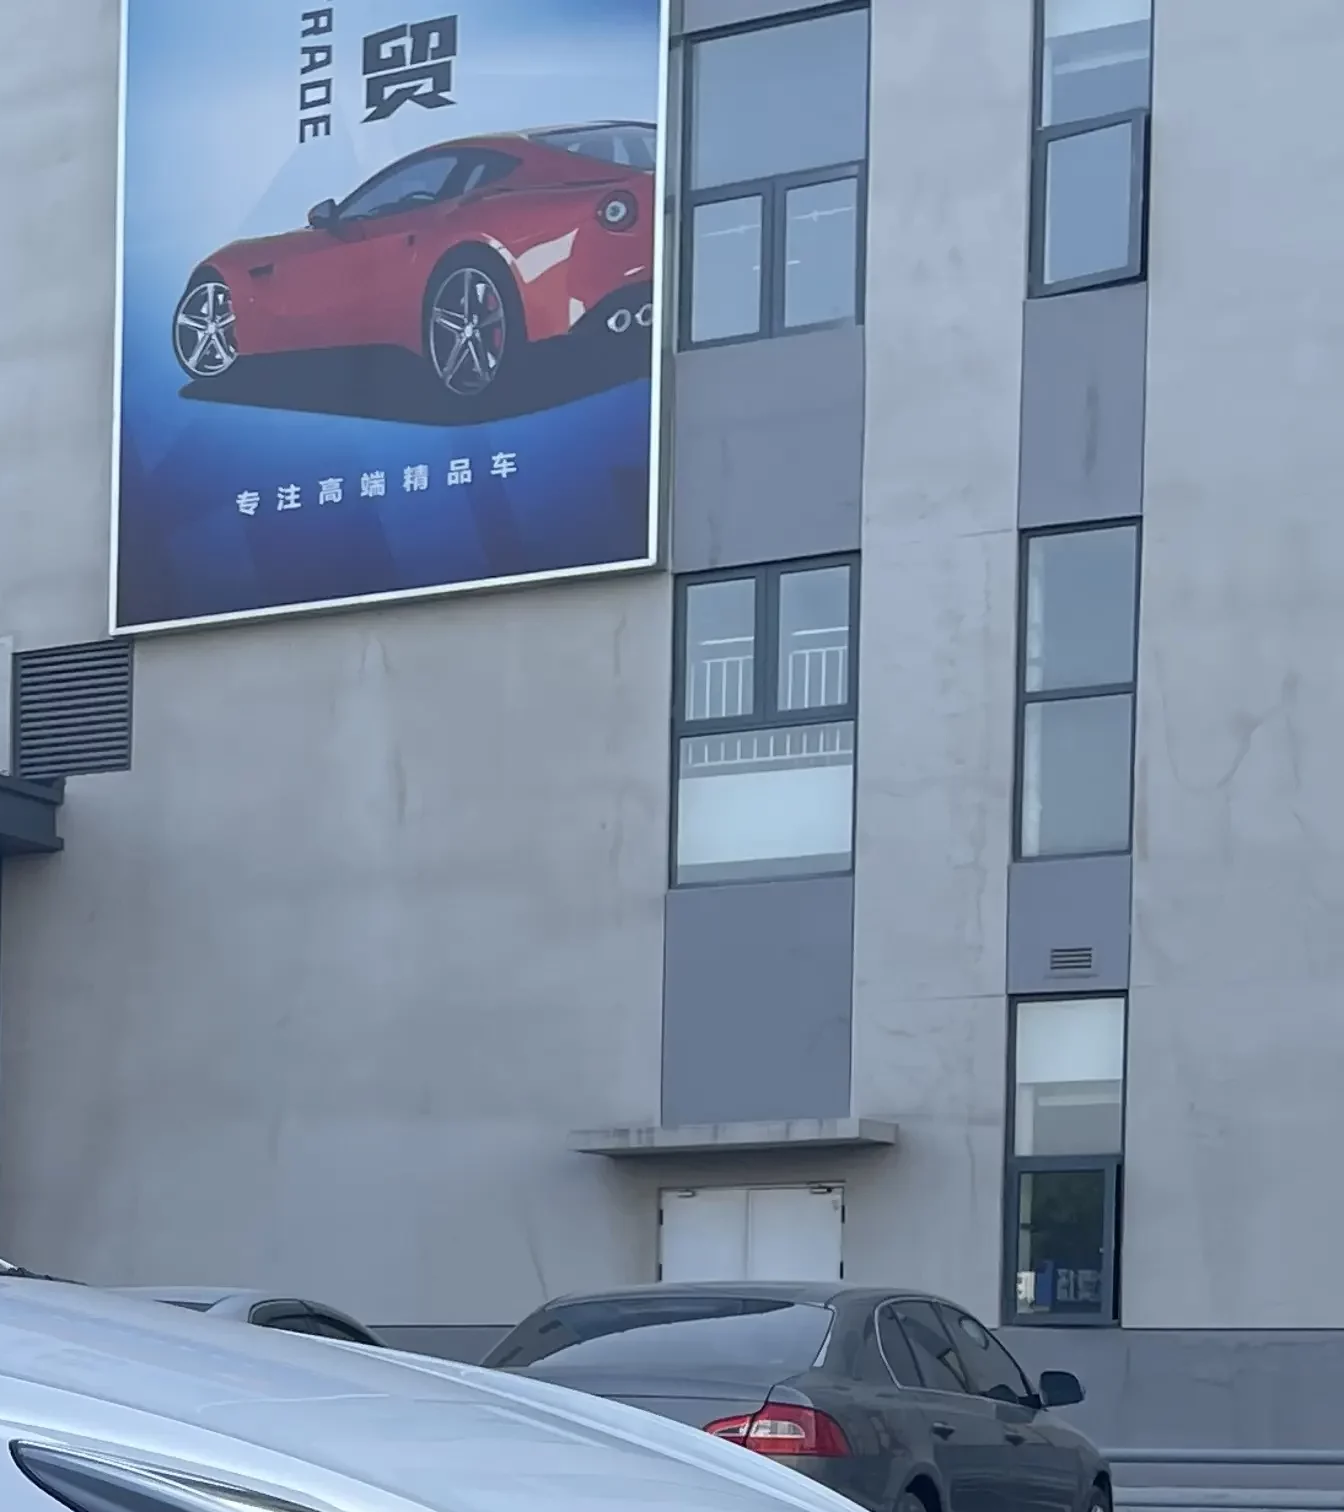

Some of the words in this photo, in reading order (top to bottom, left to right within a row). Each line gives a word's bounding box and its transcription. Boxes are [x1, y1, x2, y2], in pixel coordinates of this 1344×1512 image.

[299, 0, 334, 144] RADE
[360, 14, 458, 123] 贸
[235, 451, 518, 516] 专注高端精品车
